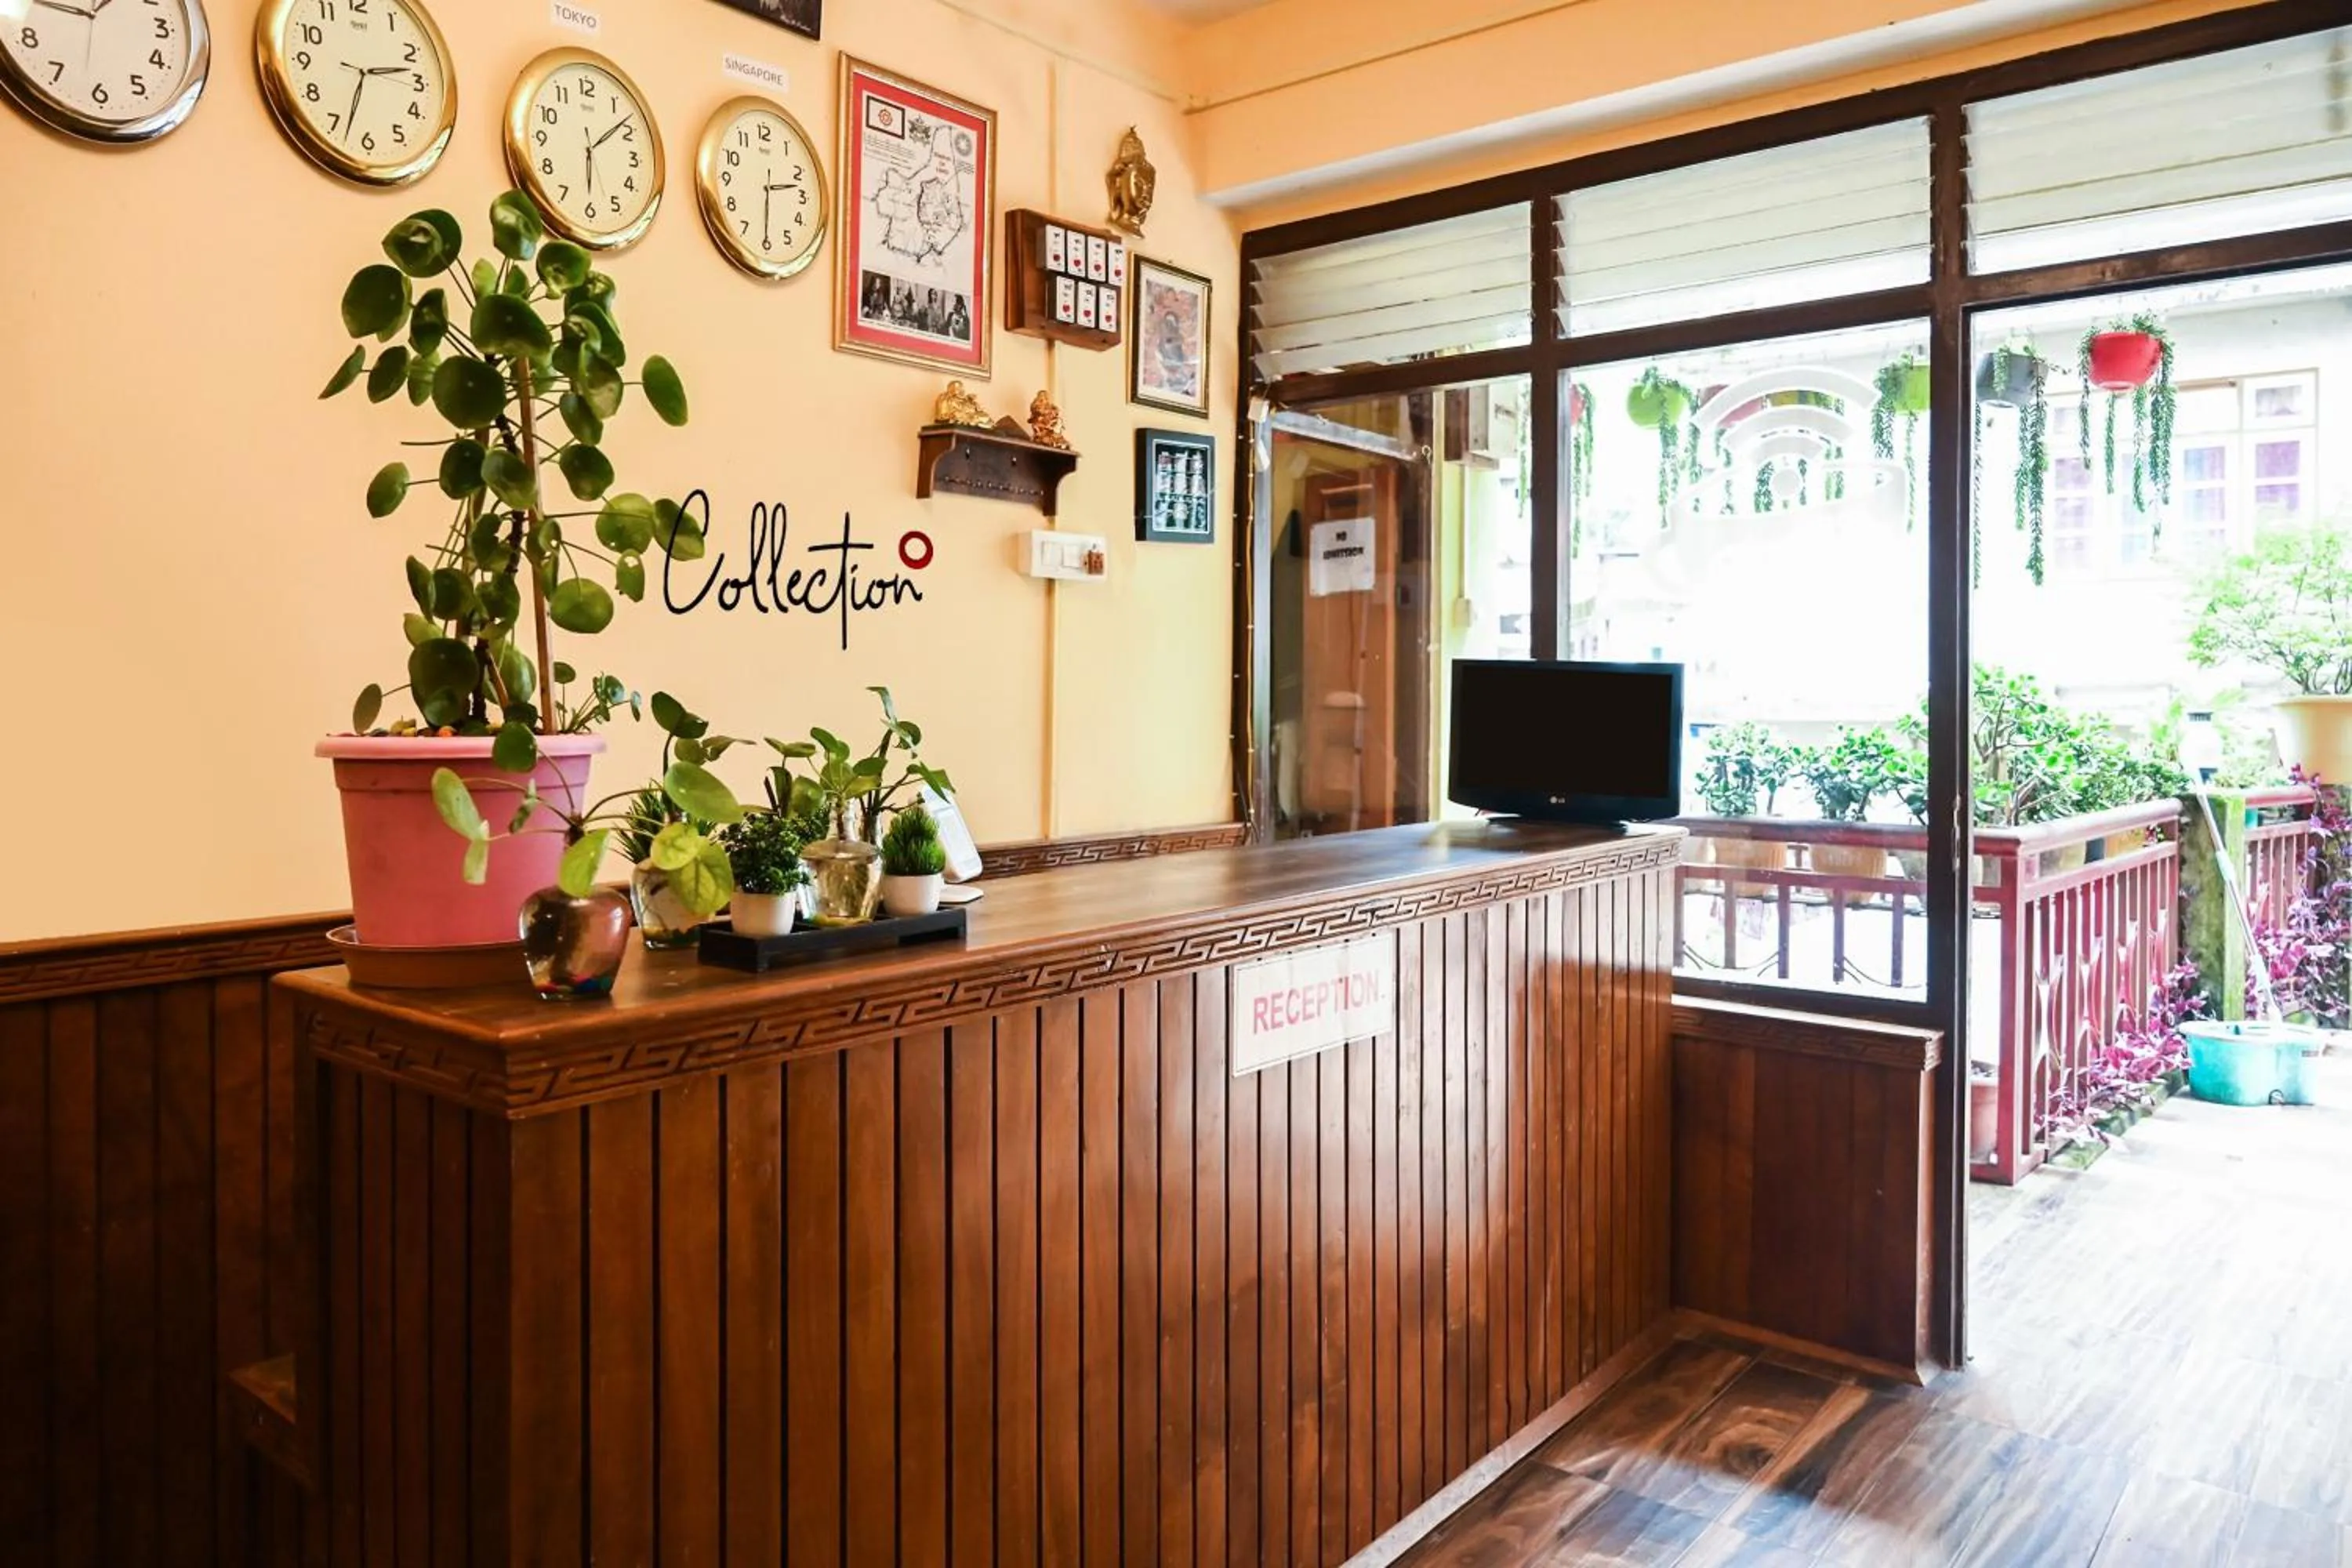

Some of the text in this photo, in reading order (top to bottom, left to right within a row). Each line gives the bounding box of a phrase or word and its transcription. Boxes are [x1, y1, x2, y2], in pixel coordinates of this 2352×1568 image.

[320, 1, 335, 21] 11
[555, 4, 597, 29] TOKYO
[154, 17, 169, 38] 3
[387, 13, 394, 32] 1
[21, 27, 38, 49] 8
[301, 23, 322, 45] 10
[149, 49, 165, 70] 4
[296, 52, 311, 71] 9
[403, 43, 416, 64] 2
[49, 60, 64, 82] 7
[724, 56, 783, 86] SINGAPORE
[129, 74, 147, 96] 5
[307, 82, 321, 102] 8
[412, 73, 425, 93] 3
[579, 78, 595, 98] 12
[92, 83, 109, 104] 6
[556, 85, 568, 104] 11
[408, 102, 421, 120] 4
[610, 96, 616, 114] 1
[327, 112, 340, 132] 7
[541, 105, 557, 125] 10
[361, 132, 375, 151] 6
[393, 124, 405, 143] 5
[535, 130, 547, 147] 9
[622, 124, 633, 142] 2
[739, 131, 749, 147] 11
[757, 124, 771, 142] 12
[543, 158, 554, 175] 8
[629, 151, 639, 168] 3
[726, 150, 740, 167] 10
[721, 171, 731, 187] 9
[793, 165, 802, 181] 2
[558, 184, 569, 201] 7
[623, 176, 634, 192] 4
[611, 196, 621, 212] 5
[727, 197, 736, 212] 8
[798, 189, 807, 205] 3
[585, 202, 596, 219] 6
[794, 212, 803, 227] 4
[740, 220, 749, 235] 7
[783, 230, 791, 245] 5
[663, 489, 923, 650] Collection
[1253, 969, 1379, 1035] RECEPTION
